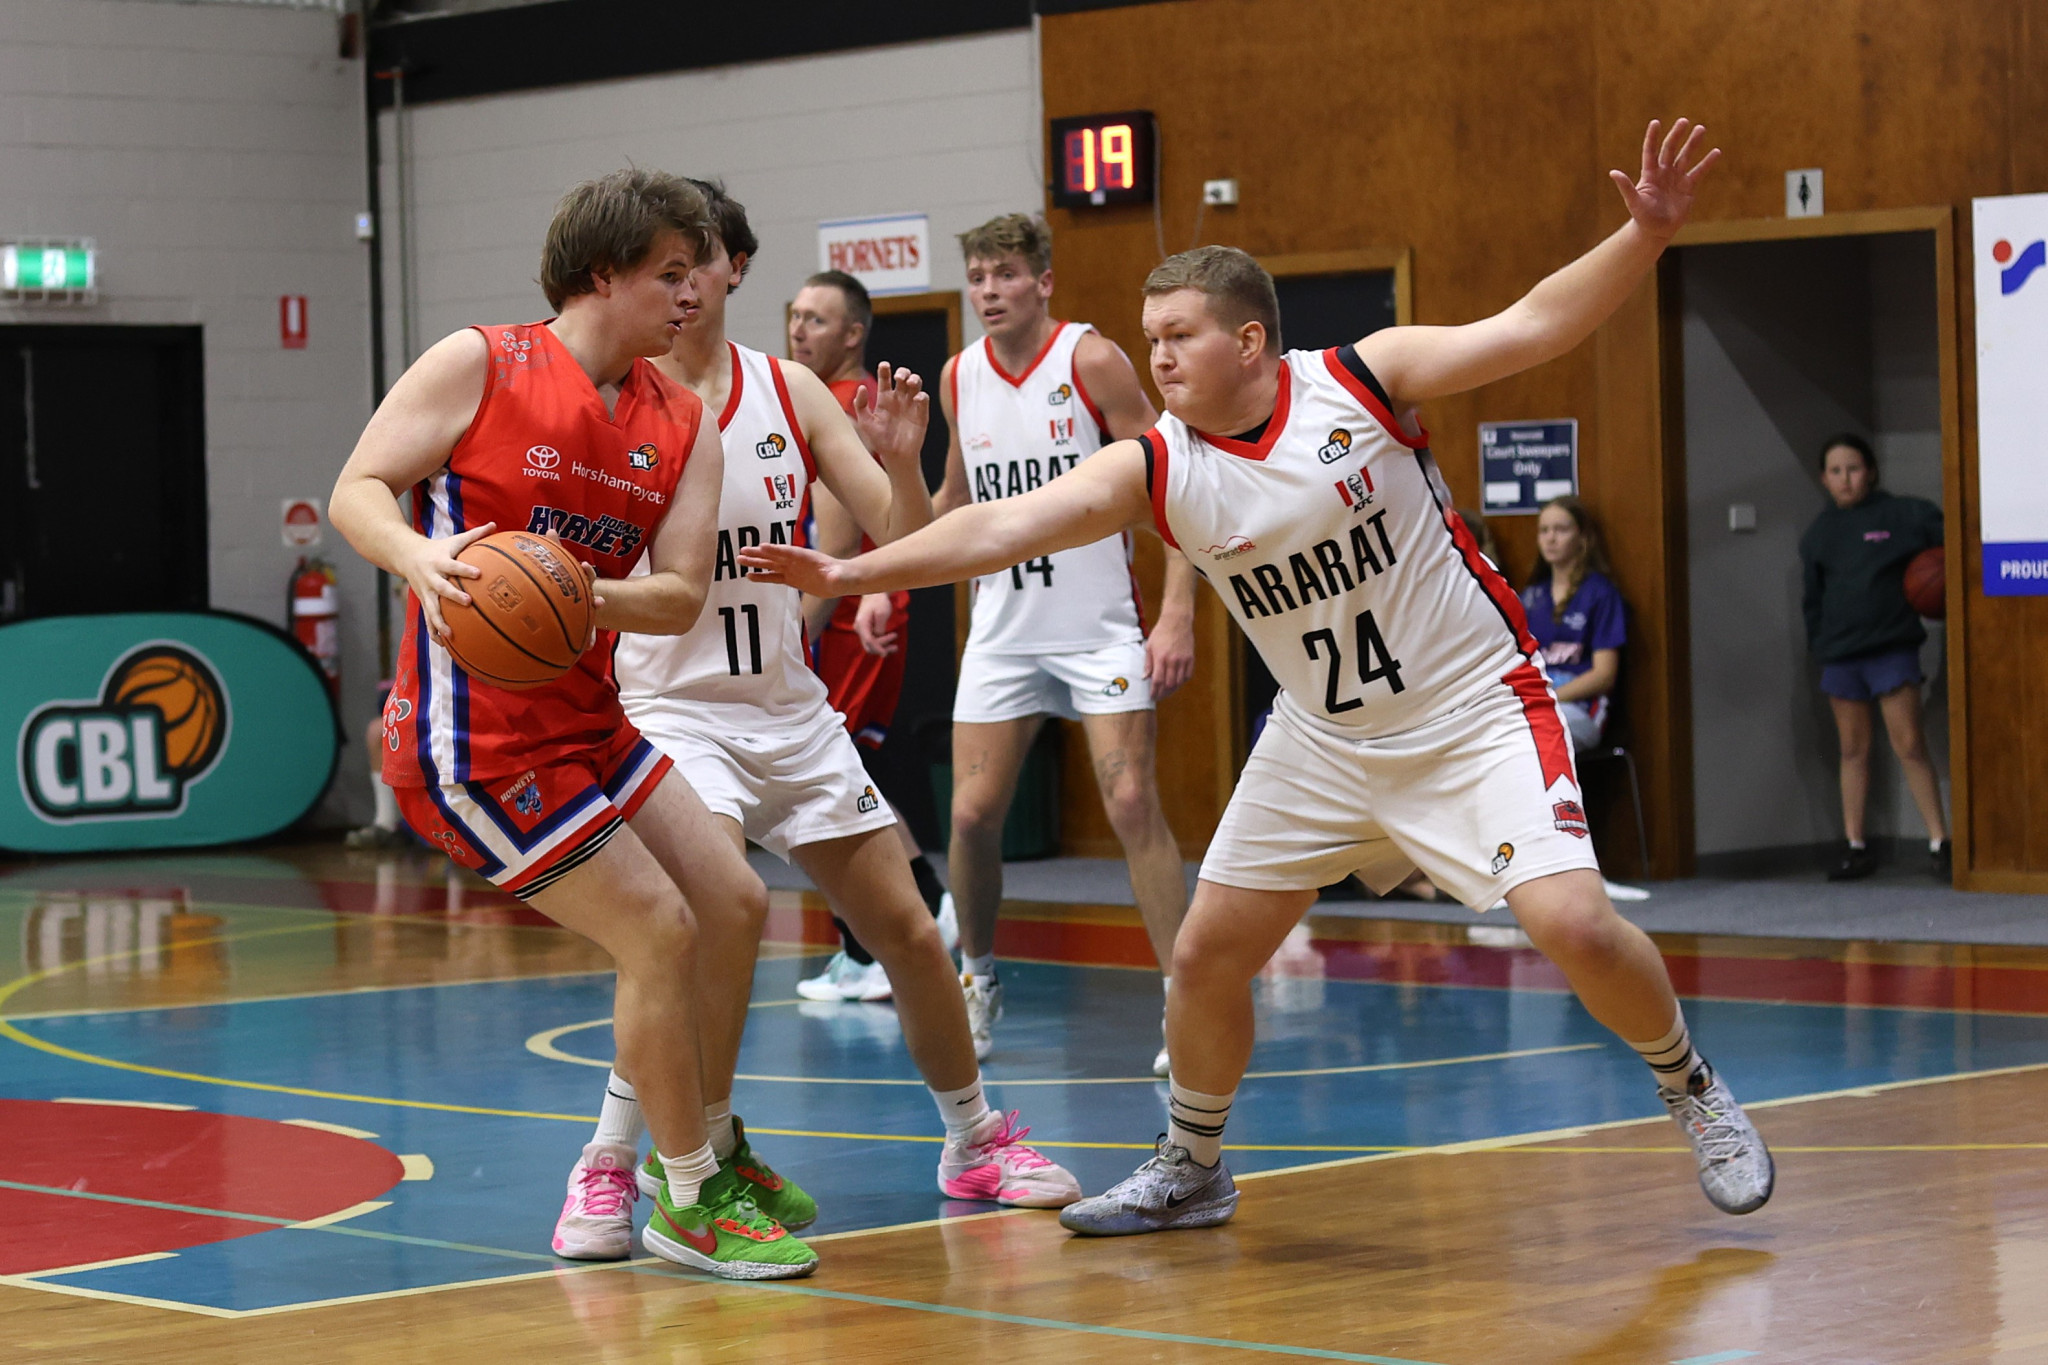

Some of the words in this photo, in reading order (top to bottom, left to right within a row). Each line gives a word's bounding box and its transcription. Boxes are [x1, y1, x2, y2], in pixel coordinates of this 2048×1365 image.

[1082, 124, 1133, 192] 19
[828, 235, 920, 272] HORNETS
[757, 442, 781, 458] CBL
[1319, 440, 1349, 463] CBL
[522, 467, 561, 482] TOYOTA
[1513, 460, 1541, 478] Only
[775, 500, 794, 510] KFC
[1353, 494, 1374, 514] KFC
[1229, 508, 1397, 619] ARARAT
[718, 604, 763, 676] 11
[1302, 609, 1406, 715] 24
[35, 717, 173, 806] CBL
[500, 769, 536, 804] HORNETS
[858, 794, 878, 812] CBL
